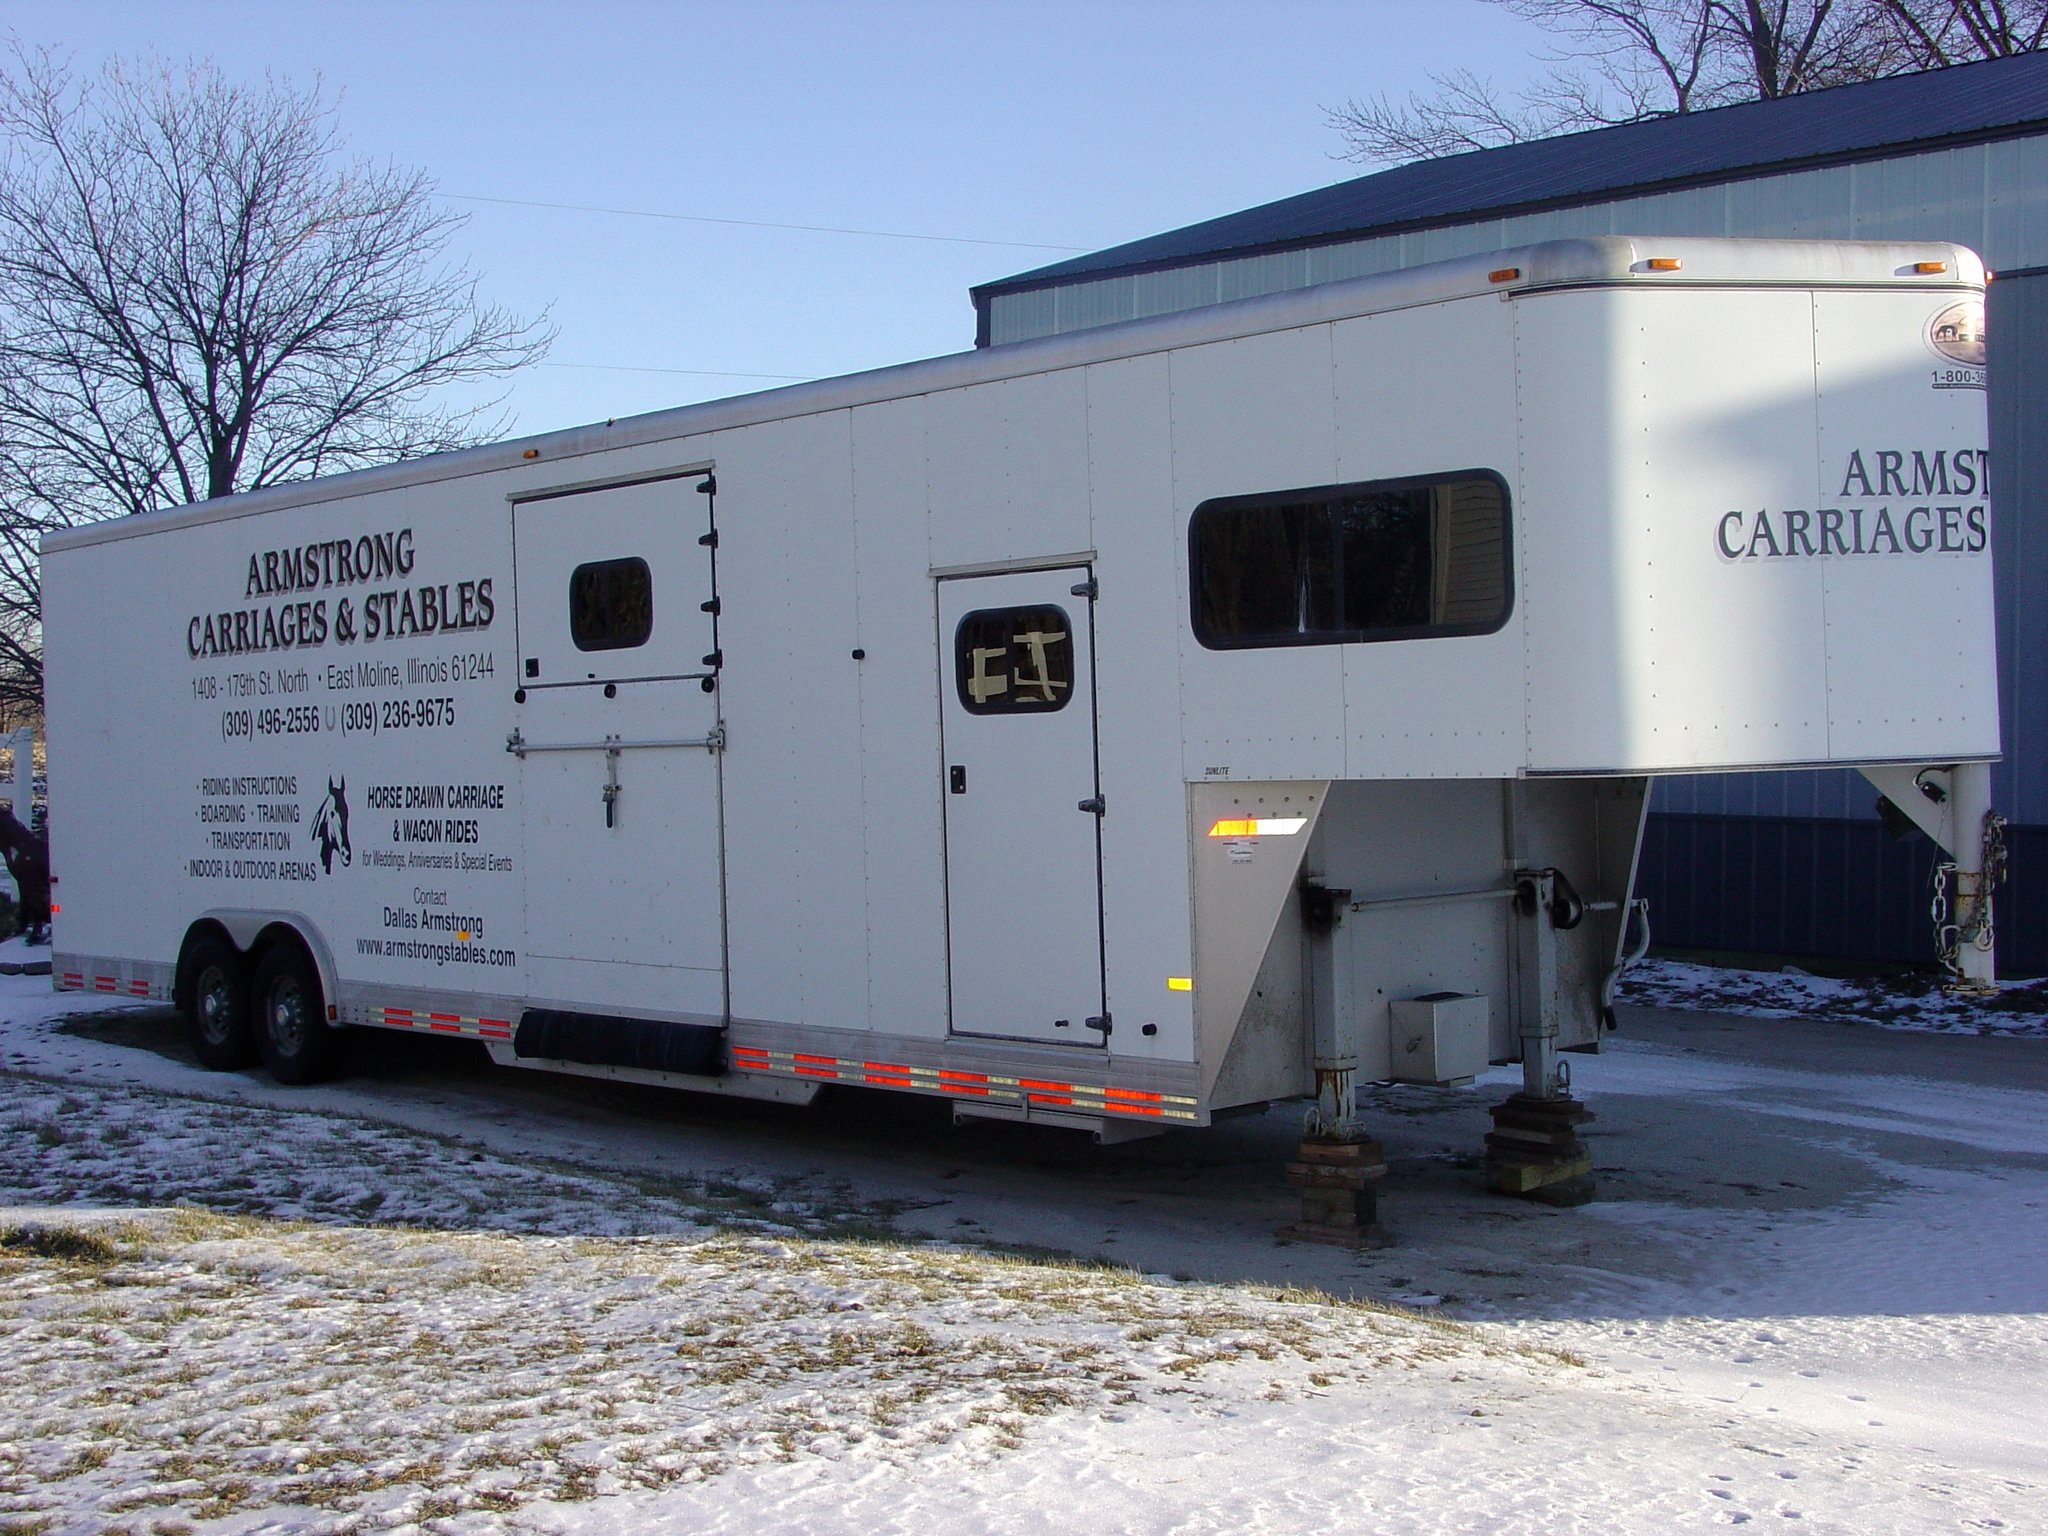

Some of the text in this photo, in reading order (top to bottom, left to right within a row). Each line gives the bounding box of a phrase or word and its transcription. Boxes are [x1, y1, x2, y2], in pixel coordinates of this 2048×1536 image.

[1716, 505, 1987, 562] CARRIAGES
[245, 528, 415, 599] ARMSTRONG
[188, 578, 495, 659] CARRIAGES & STABLES
[192, 677, 217, 700] 1408
[227, 673, 256, 697] 179th
[259, 670, 274, 695] St.
[278, 668, 309, 694] North
[327, 664, 354, 690] East
[357, 660, 403, 689] Moline,
[407, 655, 448, 685] Illinois
[451, 652, 494, 682] 61244
[222, 697, 455, 742] (309) 496-2556 (309) 236-9675
[202, 776, 297, 796] RIDING INSTRUCTIONS
[367, 784, 504, 809] HORSE DRAWN CARRIAGE
[201, 804, 300, 823] BOARDING TRAINING
[211, 832, 290, 851] TRANSPORTATION
[393, 819, 478, 844] & WAGON RIDES
[190, 859, 316, 882] INDOOR & OUTDOOR ARENAS
[362, 850, 371, 866] for
[373, 850, 406, 871] Weddings,
[408, 852, 452, 869] Anniversaries
[461, 852, 487, 873] Special
[489, 853, 512, 871] Events
[414, 887, 447, 906] Contact
[384, 907, 483, 939] Dallas Armstrong
[357, 938, 516, 967] www.armstrongstables.com
